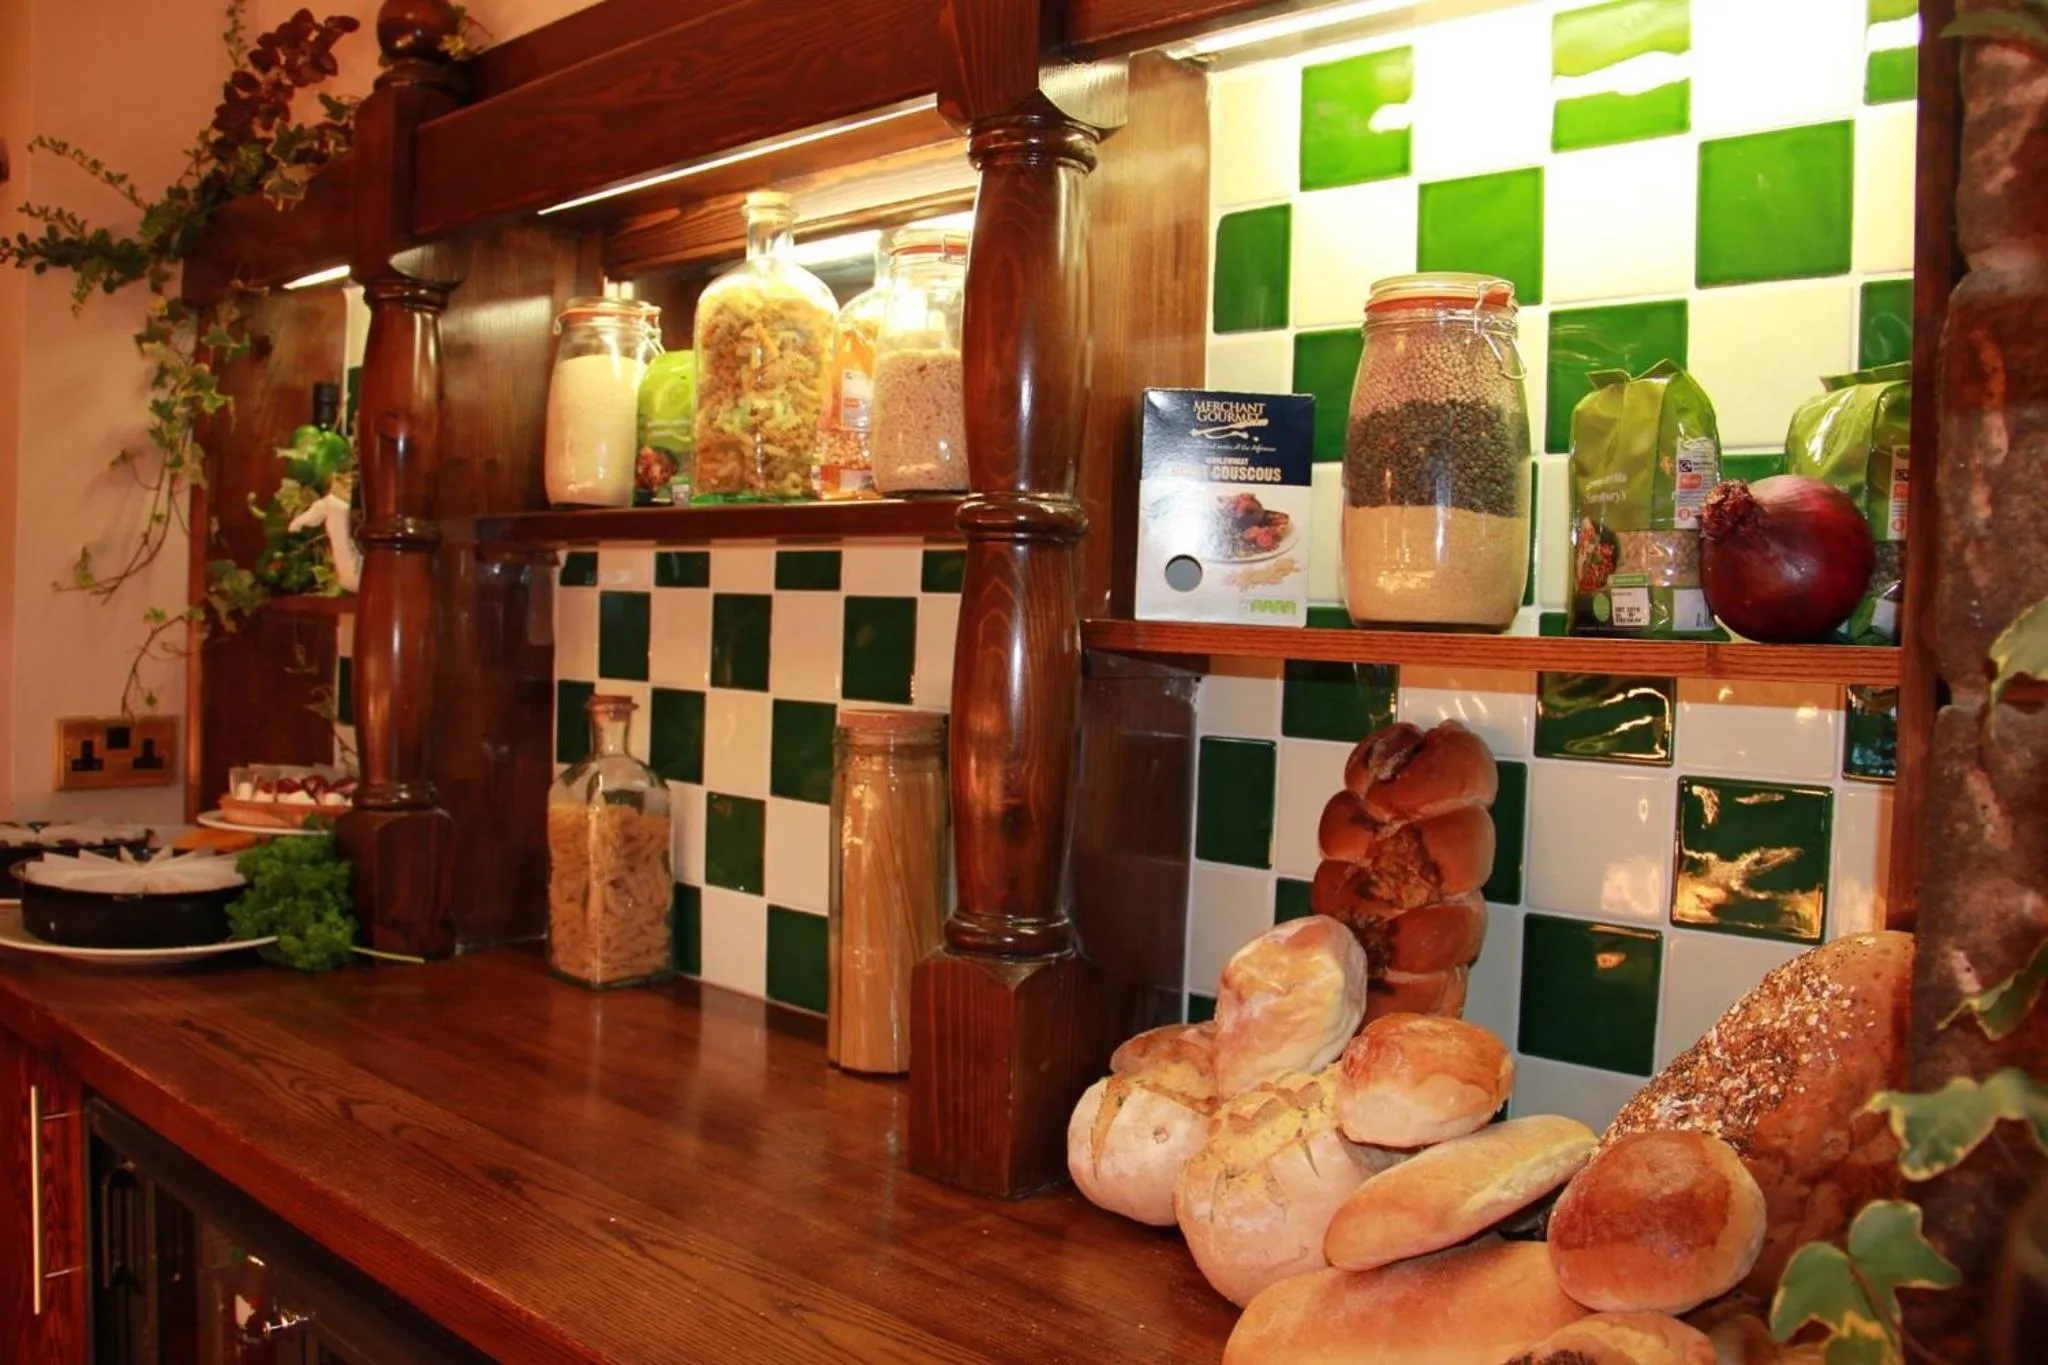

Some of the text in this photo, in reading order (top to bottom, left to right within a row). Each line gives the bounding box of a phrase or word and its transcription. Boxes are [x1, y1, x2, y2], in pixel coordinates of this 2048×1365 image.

[1193, 400, 1266, 414] MERCHANT
[1196, 411, 1262, 423] GOURMET
[1212, 466, 1282, 481] COUSCOUS
